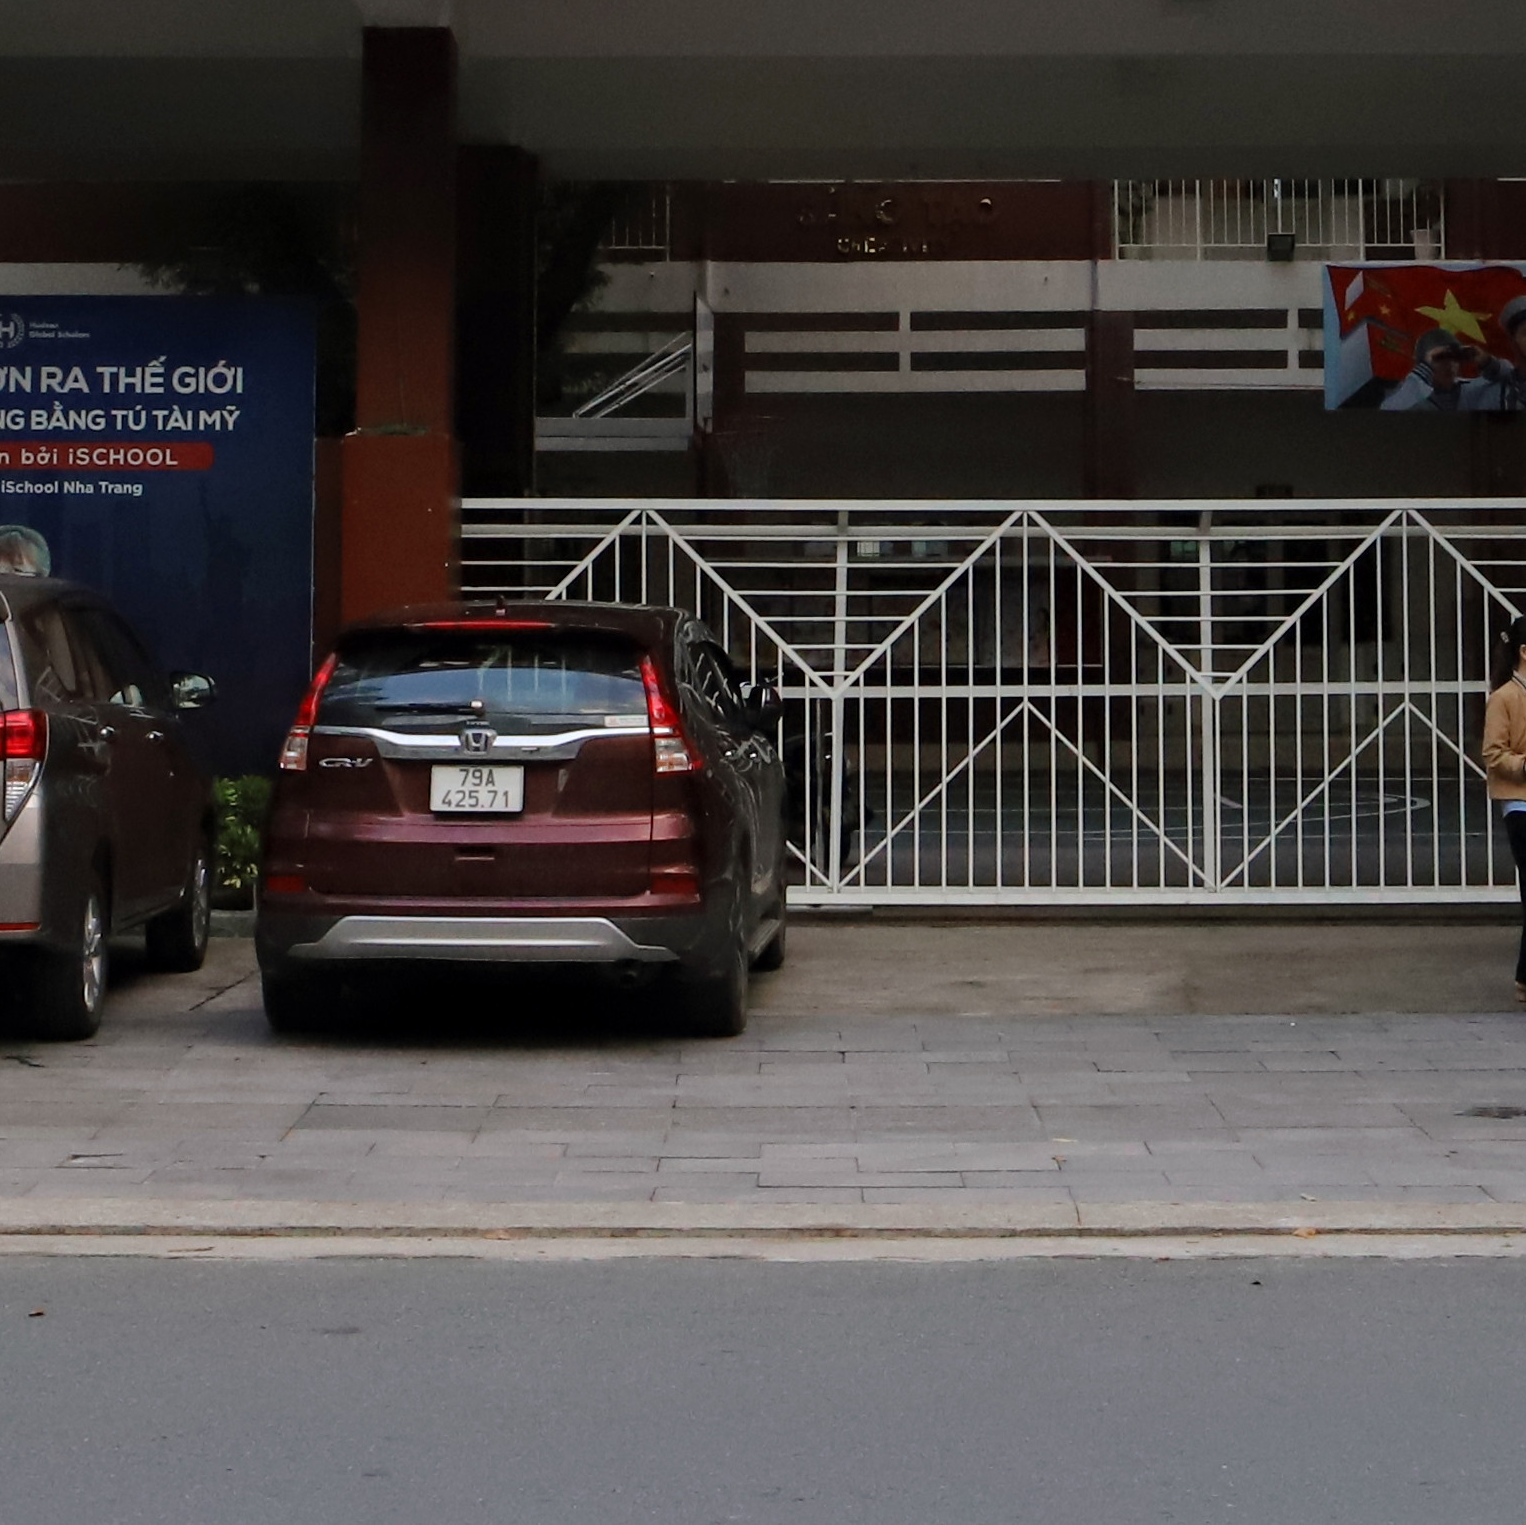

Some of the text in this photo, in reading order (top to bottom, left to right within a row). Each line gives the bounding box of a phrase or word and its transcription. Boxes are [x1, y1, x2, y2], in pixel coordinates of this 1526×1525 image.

[39, 366, 90, 394] RA
[95, 355, 168, 395] THẾ
[171, 360, 244, 395] GIỚI
[30, 400, 107, 432] BẰNG
[111, 405, 147, 431] TÚ
[152, 405, 193, 431] TÀI
[198, 405, 241, 431] MỸ
[21, 446, 59, 466] bởi
[68, 447, 179, 467] iSCHOOL
[0, 479, 59, 495] iSchool
[63, 480, 94, 495] Nha
[98, 480, 144, 496] Trang
[460, 768, 496, 787] 79A
[442, 789, 510, 809] 425.71
